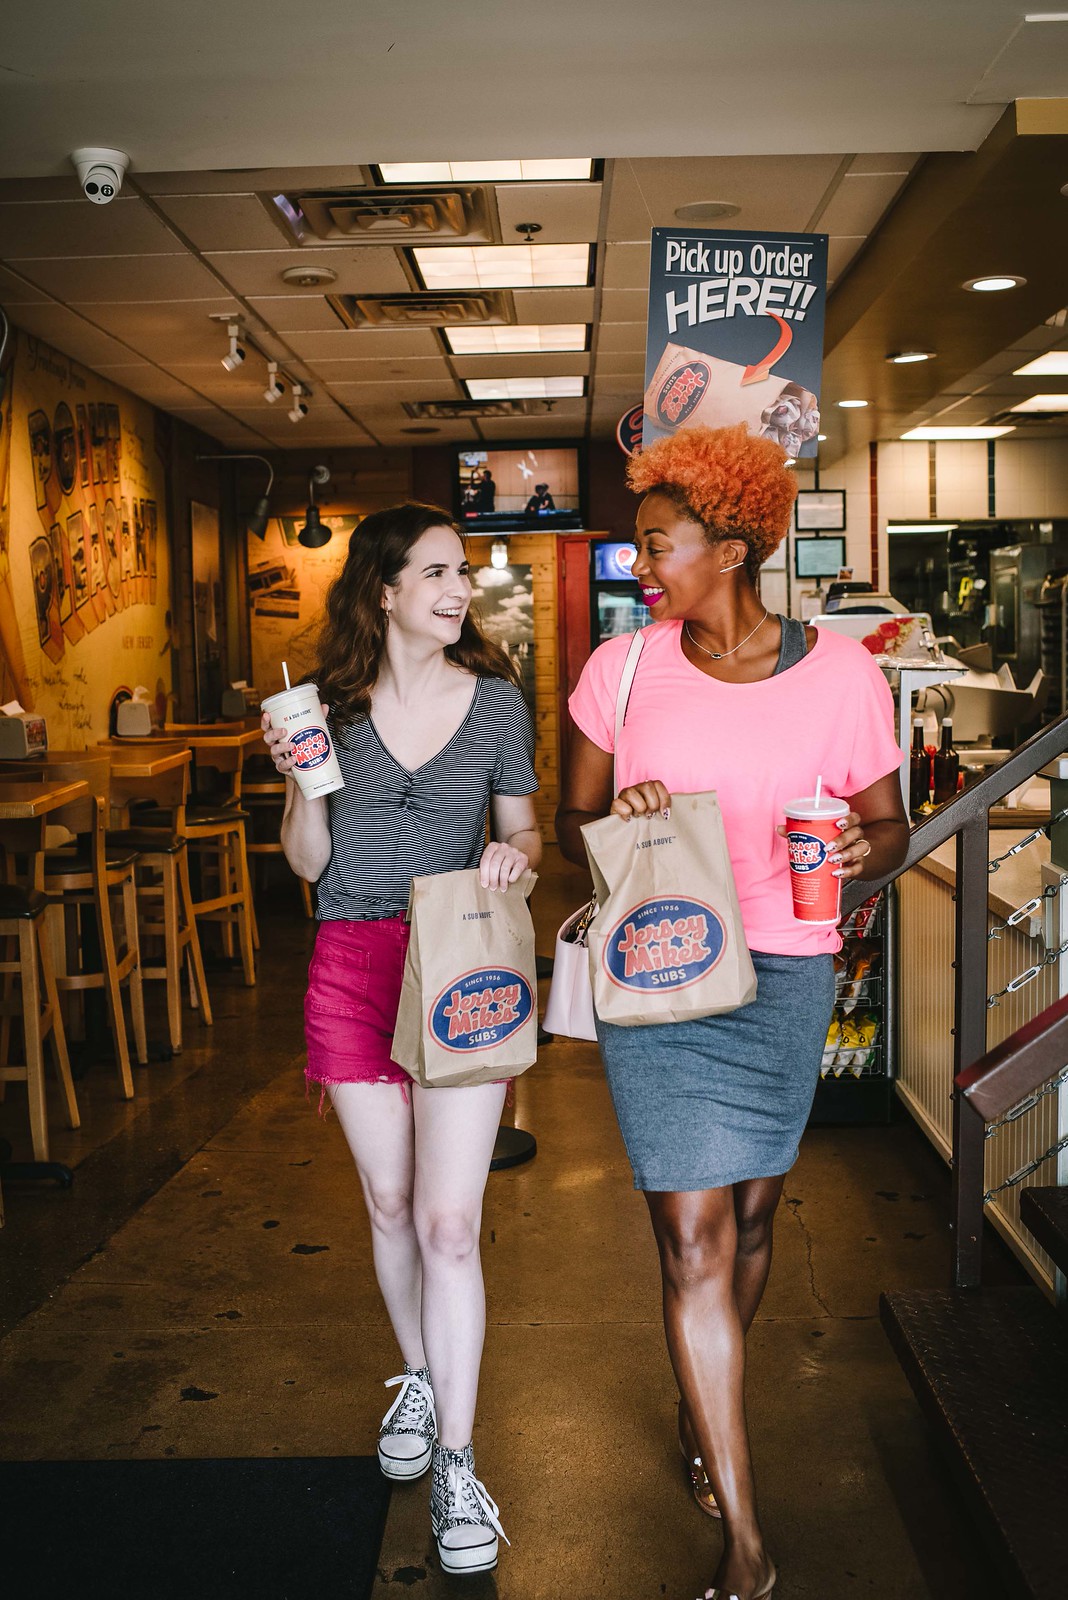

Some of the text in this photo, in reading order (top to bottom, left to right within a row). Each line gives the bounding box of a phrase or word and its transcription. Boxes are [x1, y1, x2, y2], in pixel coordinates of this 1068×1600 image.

[665, 241, 814, 279] Pick up Order
[665, 277, 818, 334] HERE!!
[308, 756, 324, 767] SUBS
[641, 840, 652, 849] SUB
[788, 841, 821, 854] ersey
[462, 913, 467, 921] A
[467, 912, 479, 920] SUB
[637, 904, 679, 919] SINCE 1956
[618, 913, 708, 952] Jersey
[625, 938, 711, 978] Mike's
[465, 974, 501, 988] SINCE 1956
[651, 968, 687, 985] SUBS
[443, 983, 521, 1017] Jersey
[449, 1003, 519, 1040] Mike's
[468, 1030, 498, 1045] SUBS
